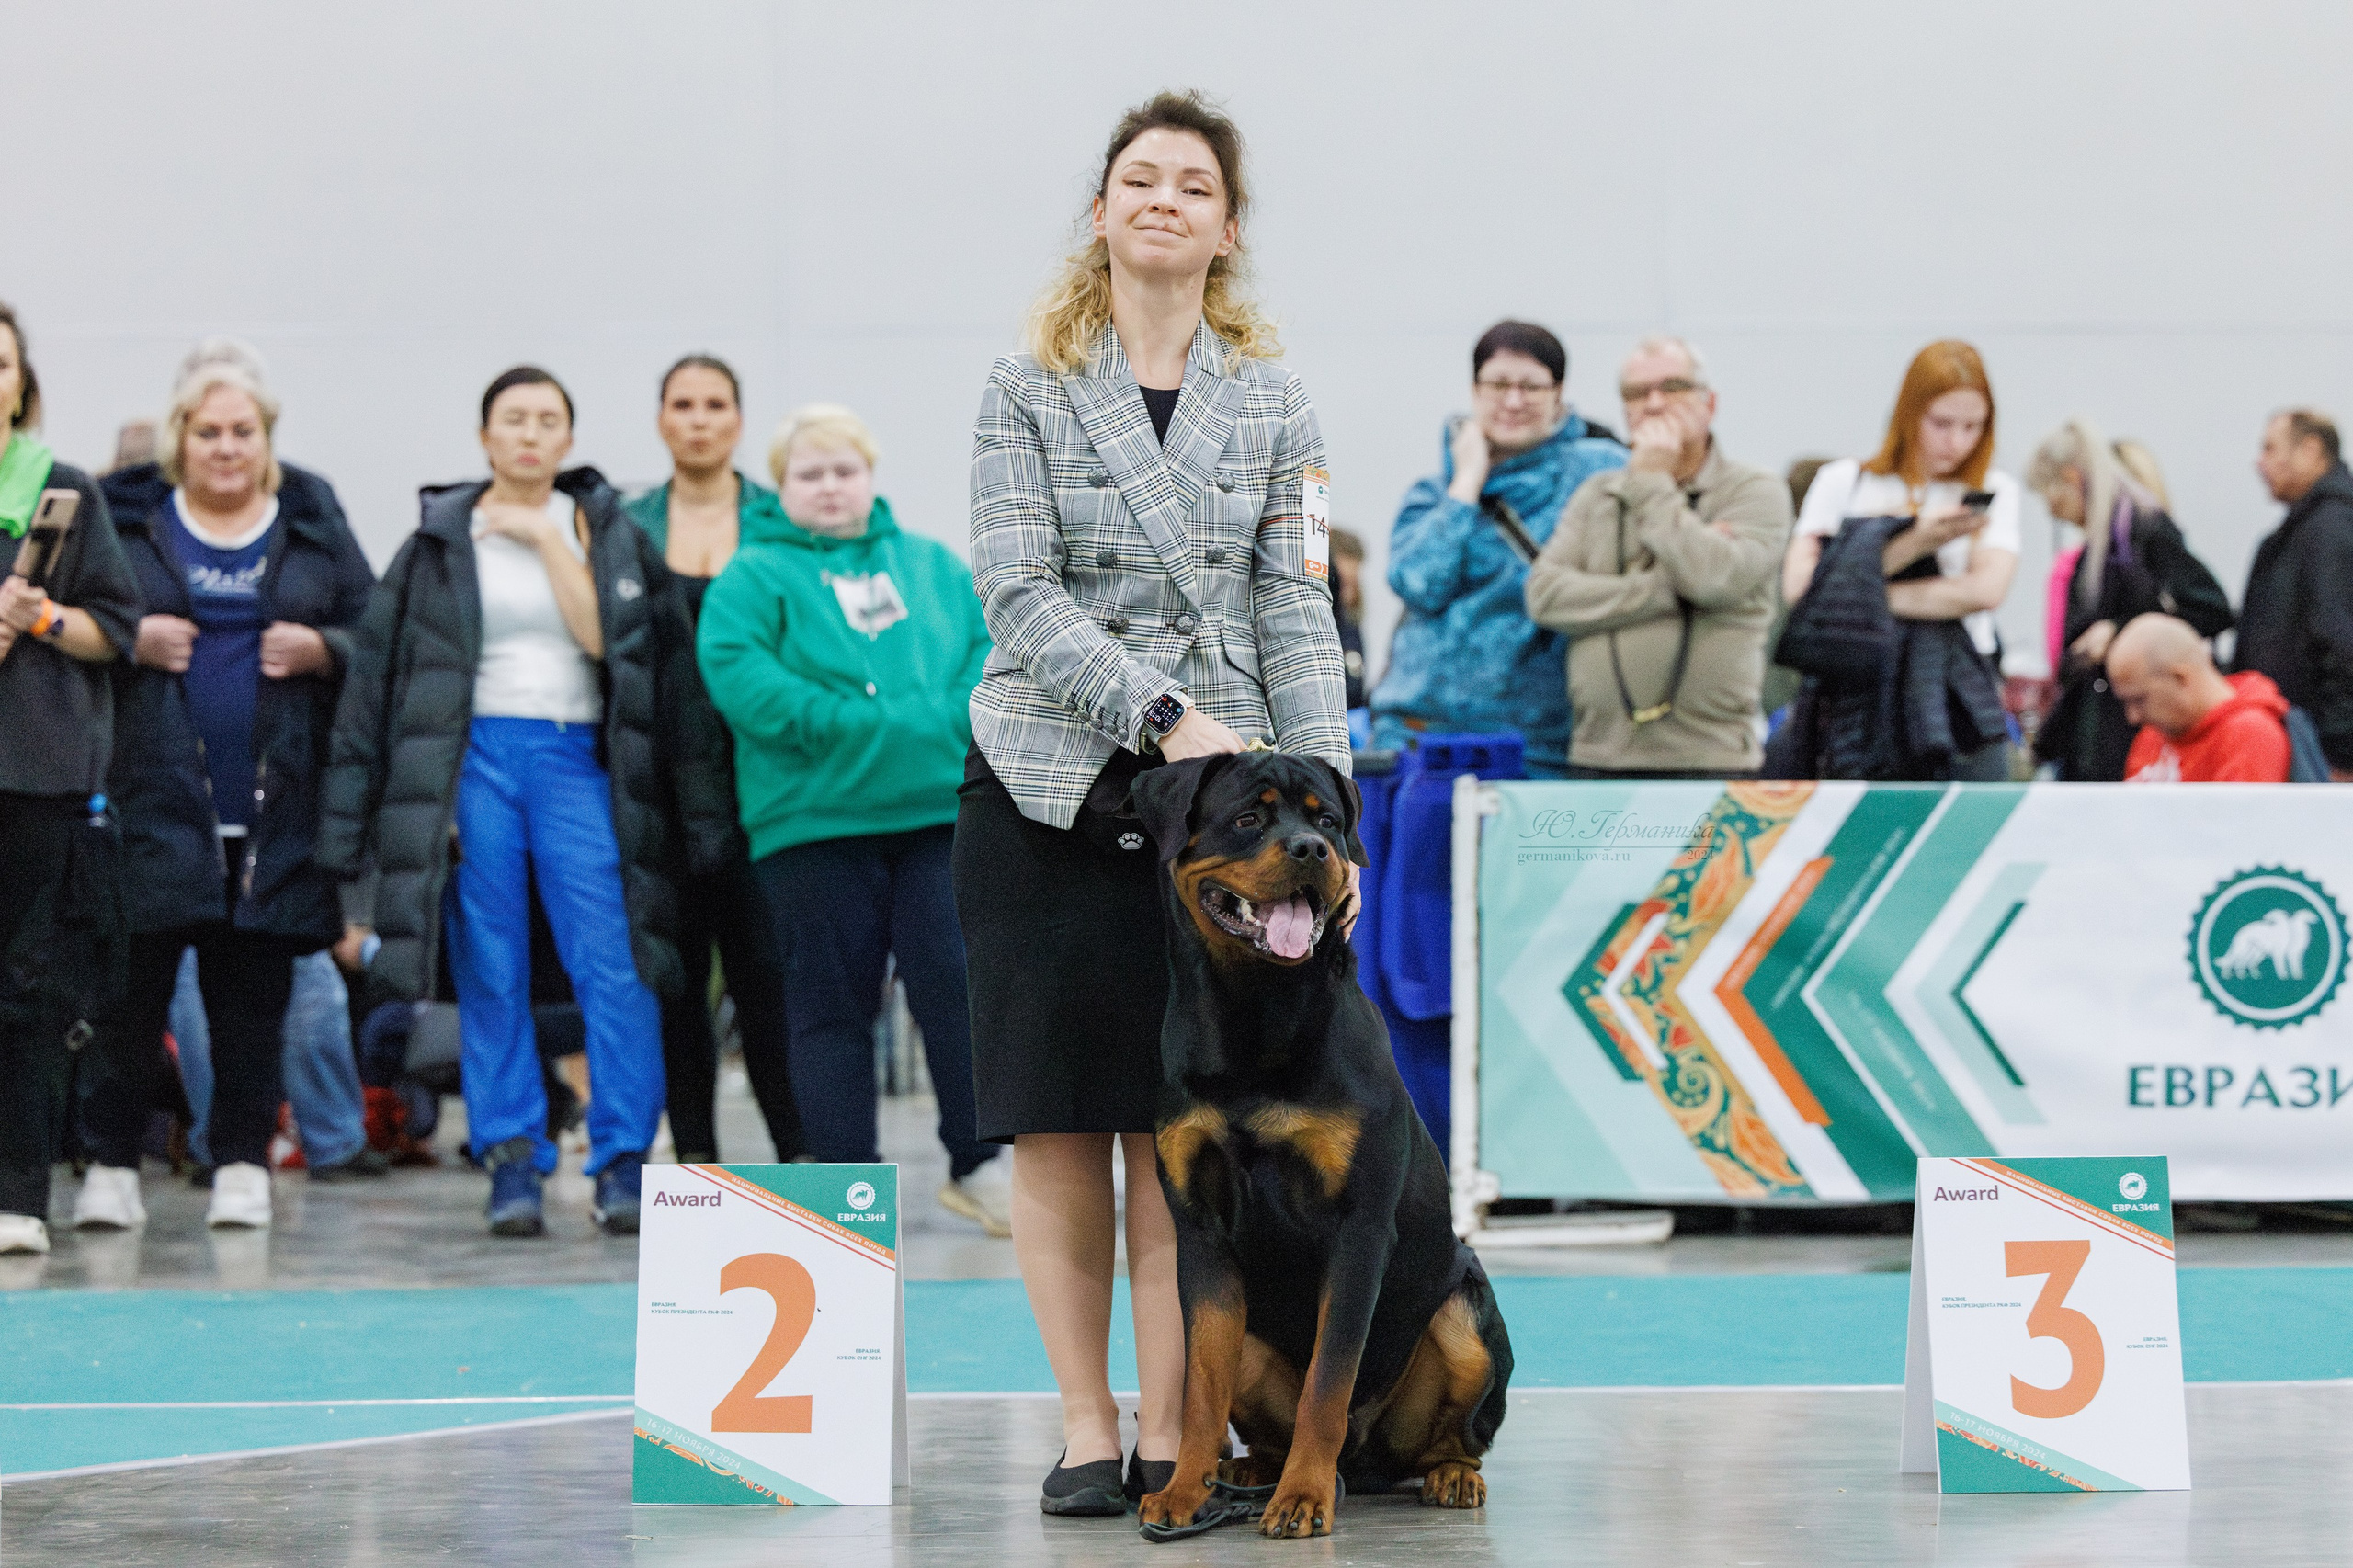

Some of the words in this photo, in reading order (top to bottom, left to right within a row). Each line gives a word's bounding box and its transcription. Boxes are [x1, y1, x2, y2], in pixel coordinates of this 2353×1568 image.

[653, 1190, 722, 1207] Award
[731, 1176, 785, 1207] НАЦИОНАЛЬНЫЕ
[787, 1202, 822, 1223] ВЫСТАВКИ
[823, 1221, 845, 1235] СОБАК
[846, 1232, 862, 1244] ВСЕХ
[864, 1241, 887, 1256] ПОРОД
[837, 1212, 886, 1222] ЕВРАЗИЯ
[1934, 1185, 1999, 1202] Award
[2006, 1170, 2061, 1199] НАЦИОНАЛЬНЫЕ
[2062, 1194, 2097, 1216] ВЫСТАВКИ
[2098, 1210, 2120, 1226] СОБАК
[2121, 1221, 2139, 1234] ВСЕХ
[2140, 1229, 2164, 1244] ПОРОД
[2112, 1203, 2160, 1213] ЕВРАЗИЯ
[711, 1253, 816, 1433] 2
[2004, 1240, 2105, 1418] 3
[647, 1417, 673, 1435] 16-17
[674, 1431, 715, 1457] НОЯБРЯ
[717, 1451, 742, 1470] 2024
[1949, 1412, 1976, 1428] 16-17
[1977, 1424, 2019, 1449] НОЯБРЯ
[2021, 1443, 2046, 1460] 2024
